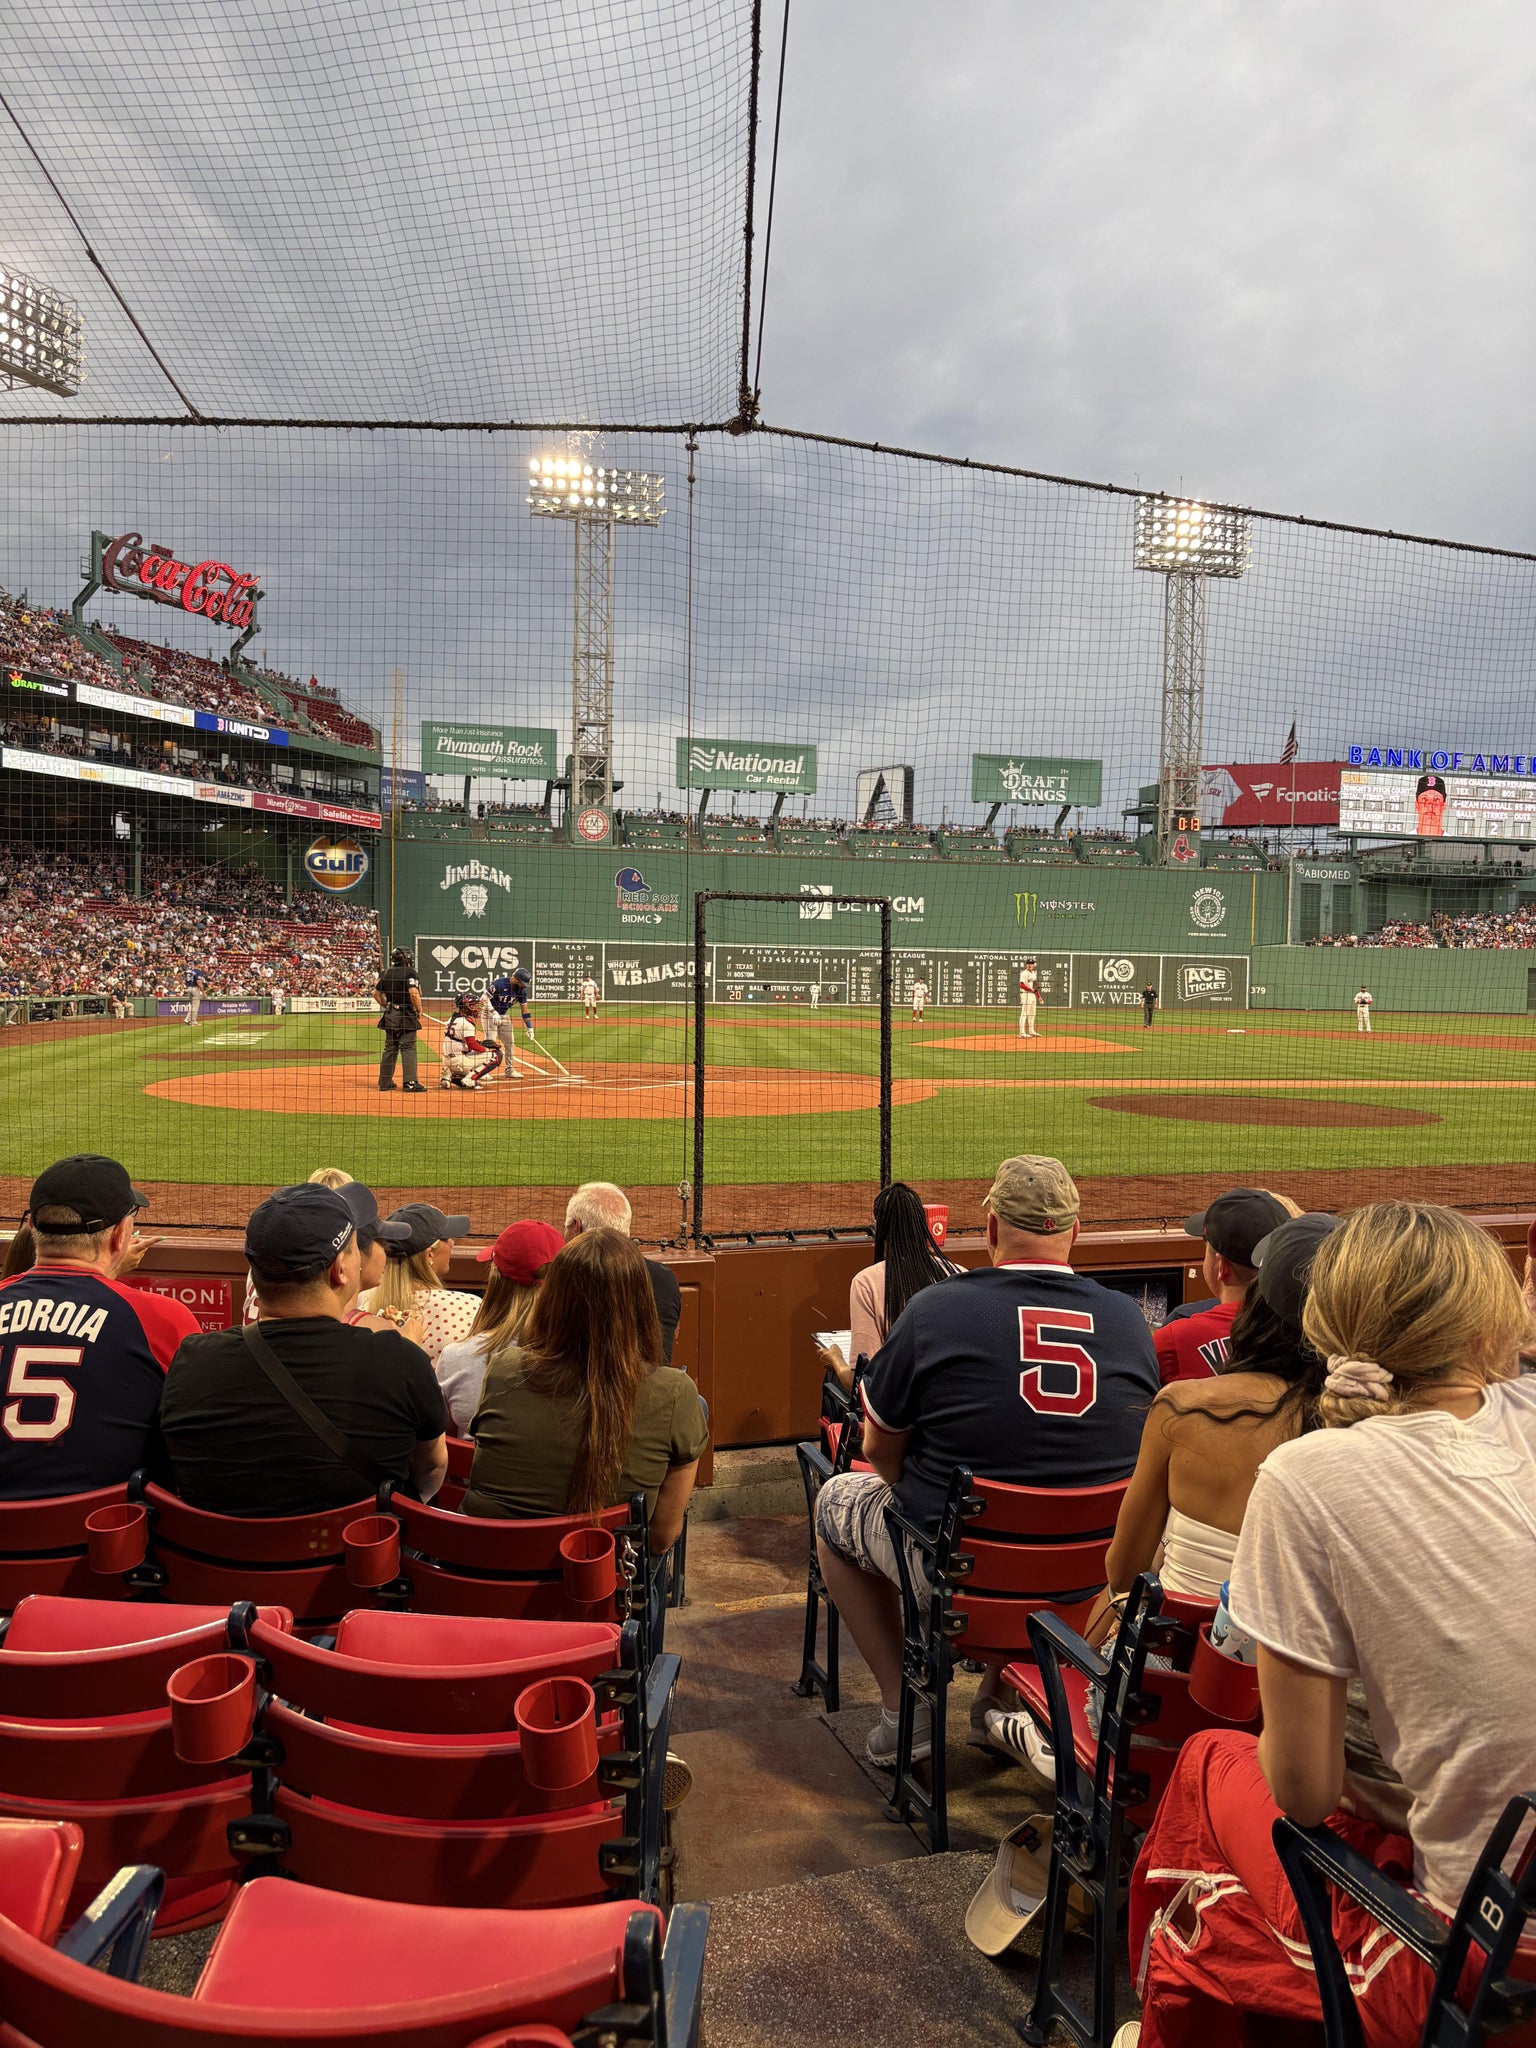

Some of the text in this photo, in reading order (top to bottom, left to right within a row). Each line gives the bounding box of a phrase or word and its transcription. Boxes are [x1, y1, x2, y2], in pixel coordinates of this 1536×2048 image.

[102, 532, 261, 627] Coca-Cola
[10, 678, 69, 697] DRAFTKINGS
[229, 720, 270, 741] UNITED
[436, 736, 543, 757] Plymouth Rock
[495, 755, 544, 766] assurance
[715, 751, 801, 774] National
[1350, 744, 1423, 769] BANK
[1431, 750, 1464, 770] OF
[746, 774, 800, 785] Car Rental
[1003, 773, 1069, 789] DRAFT
[1011, 787, 1067, 802] KINGS
[323, 808, 352, 821] Safelite
[1178, 817, 1200, 831] 0:13
[1464, 820, 1525, 837] 1 2 1
[308, 852, 364, 873] Gulf
[440, 859, 513, 893] JIM BEAM
[1304, 869, 1351, 880] ABIOMED
[622, 892, 679, 903] RED SOX
[1040, 900, 1095, 911] MONSTER
[622, 903, 679, 912] SCHOLARS
[622, 914, 652, 924] BIDMC
[461, 945, 519, 970] CVS
[607, 961, 624, 969] WHO
[1098, 958, 1135, 982] 160
[1188, 967, 1226, 983] ACE
[1188, 981, 1227, 993] TICKET
[1250, 986, 1266, 995] 379
[1081, 992, 1143, 1005] F.W. WEB
[170, 1002, 191, 1014] xfinit
[0, 1298, 109, 1343] EDROIA
[201, 1321, 224, 1330] NET
[1018, 1306, 1098, 1418] 5
[1197, 1336, 1231, 1376] V
[0, 1345, 85, 1442] 5
[1480, 1896, 1504, 1931] B
